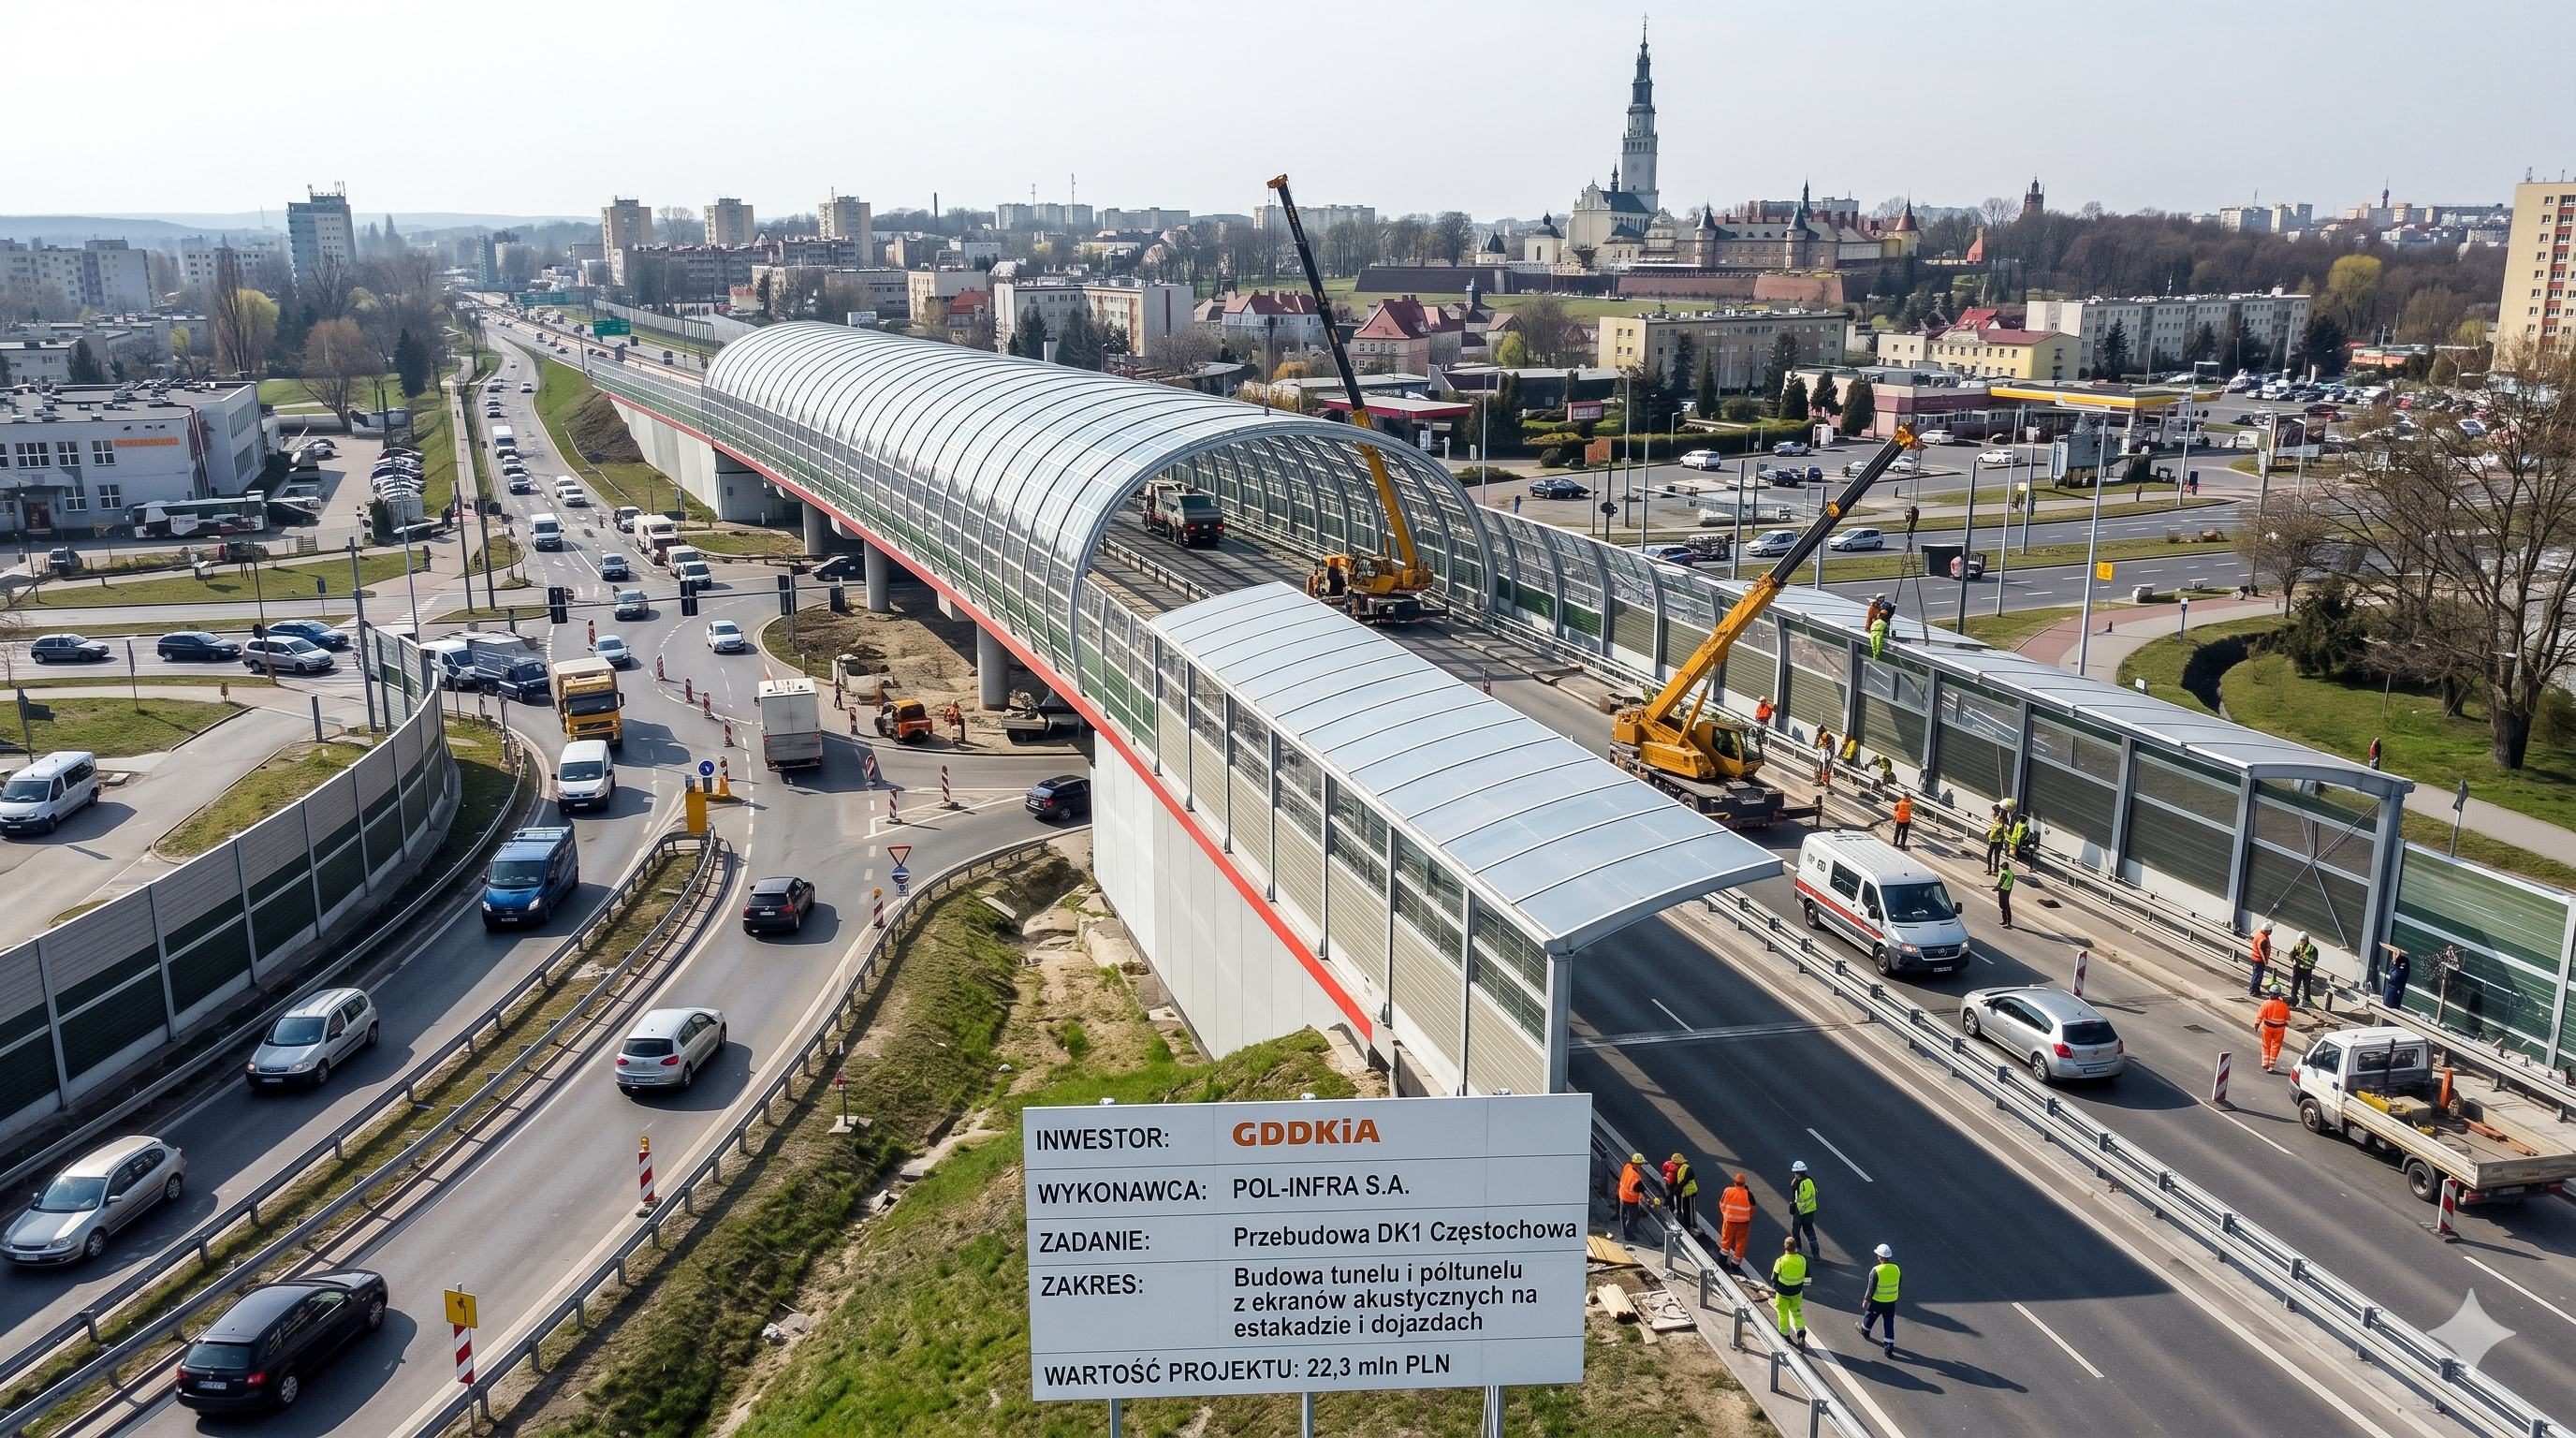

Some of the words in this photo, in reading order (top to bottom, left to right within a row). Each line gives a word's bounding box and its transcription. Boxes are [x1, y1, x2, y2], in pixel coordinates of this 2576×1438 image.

[1036, 1127, 1169, 1151] INWESTOR:
[1233, 1119, 1379, 1147] GDDKiA
[1037, 1180, 1207, 1205] WYKONAWCA:
[1233, 1175, 1360, 1199] POL-INFRA
[1365, 1174, 1410, 1196] S.A.
[1039, 1229, 1149, 1254] ZADANIE:
[1234, 1225, 1370, 1247] Przebudowa
[1378, 1222, 1420, 1243] DK1
[1430, 1219, 1577, 1246] Częstochowa
[1041, 1273, 1143, 1297] ZAKRES:
[1235, 1266, 1324, 1287] Budowa
[1330, 1263, 1399, 1284] tunelu
[1407, 1262, 1412, 1283] i
[1233, 1297, 1246, 1313] z
[1251, 1289, 1347, 1312] ekranów
[1353, 1285, 1503, 1313] akustycznych
[1512, 1288, 1537, 1304] na
[1234, 1314, 1352, 1338] estakadzie
[1359, 1313, 1364, 1334] i
[1370, 1312, 1483, 1338] dojazdach
[1044, 1357, 1162, 1387] WARTOŚĆ
[1169, 1358, 1299, 1383] PROJEKTU:
[1307, 1357, 1352, 1381] 22,3
[1358, 1356, 1398, 1376] mln
[1406, 1353, 1450, 1374] PLN
